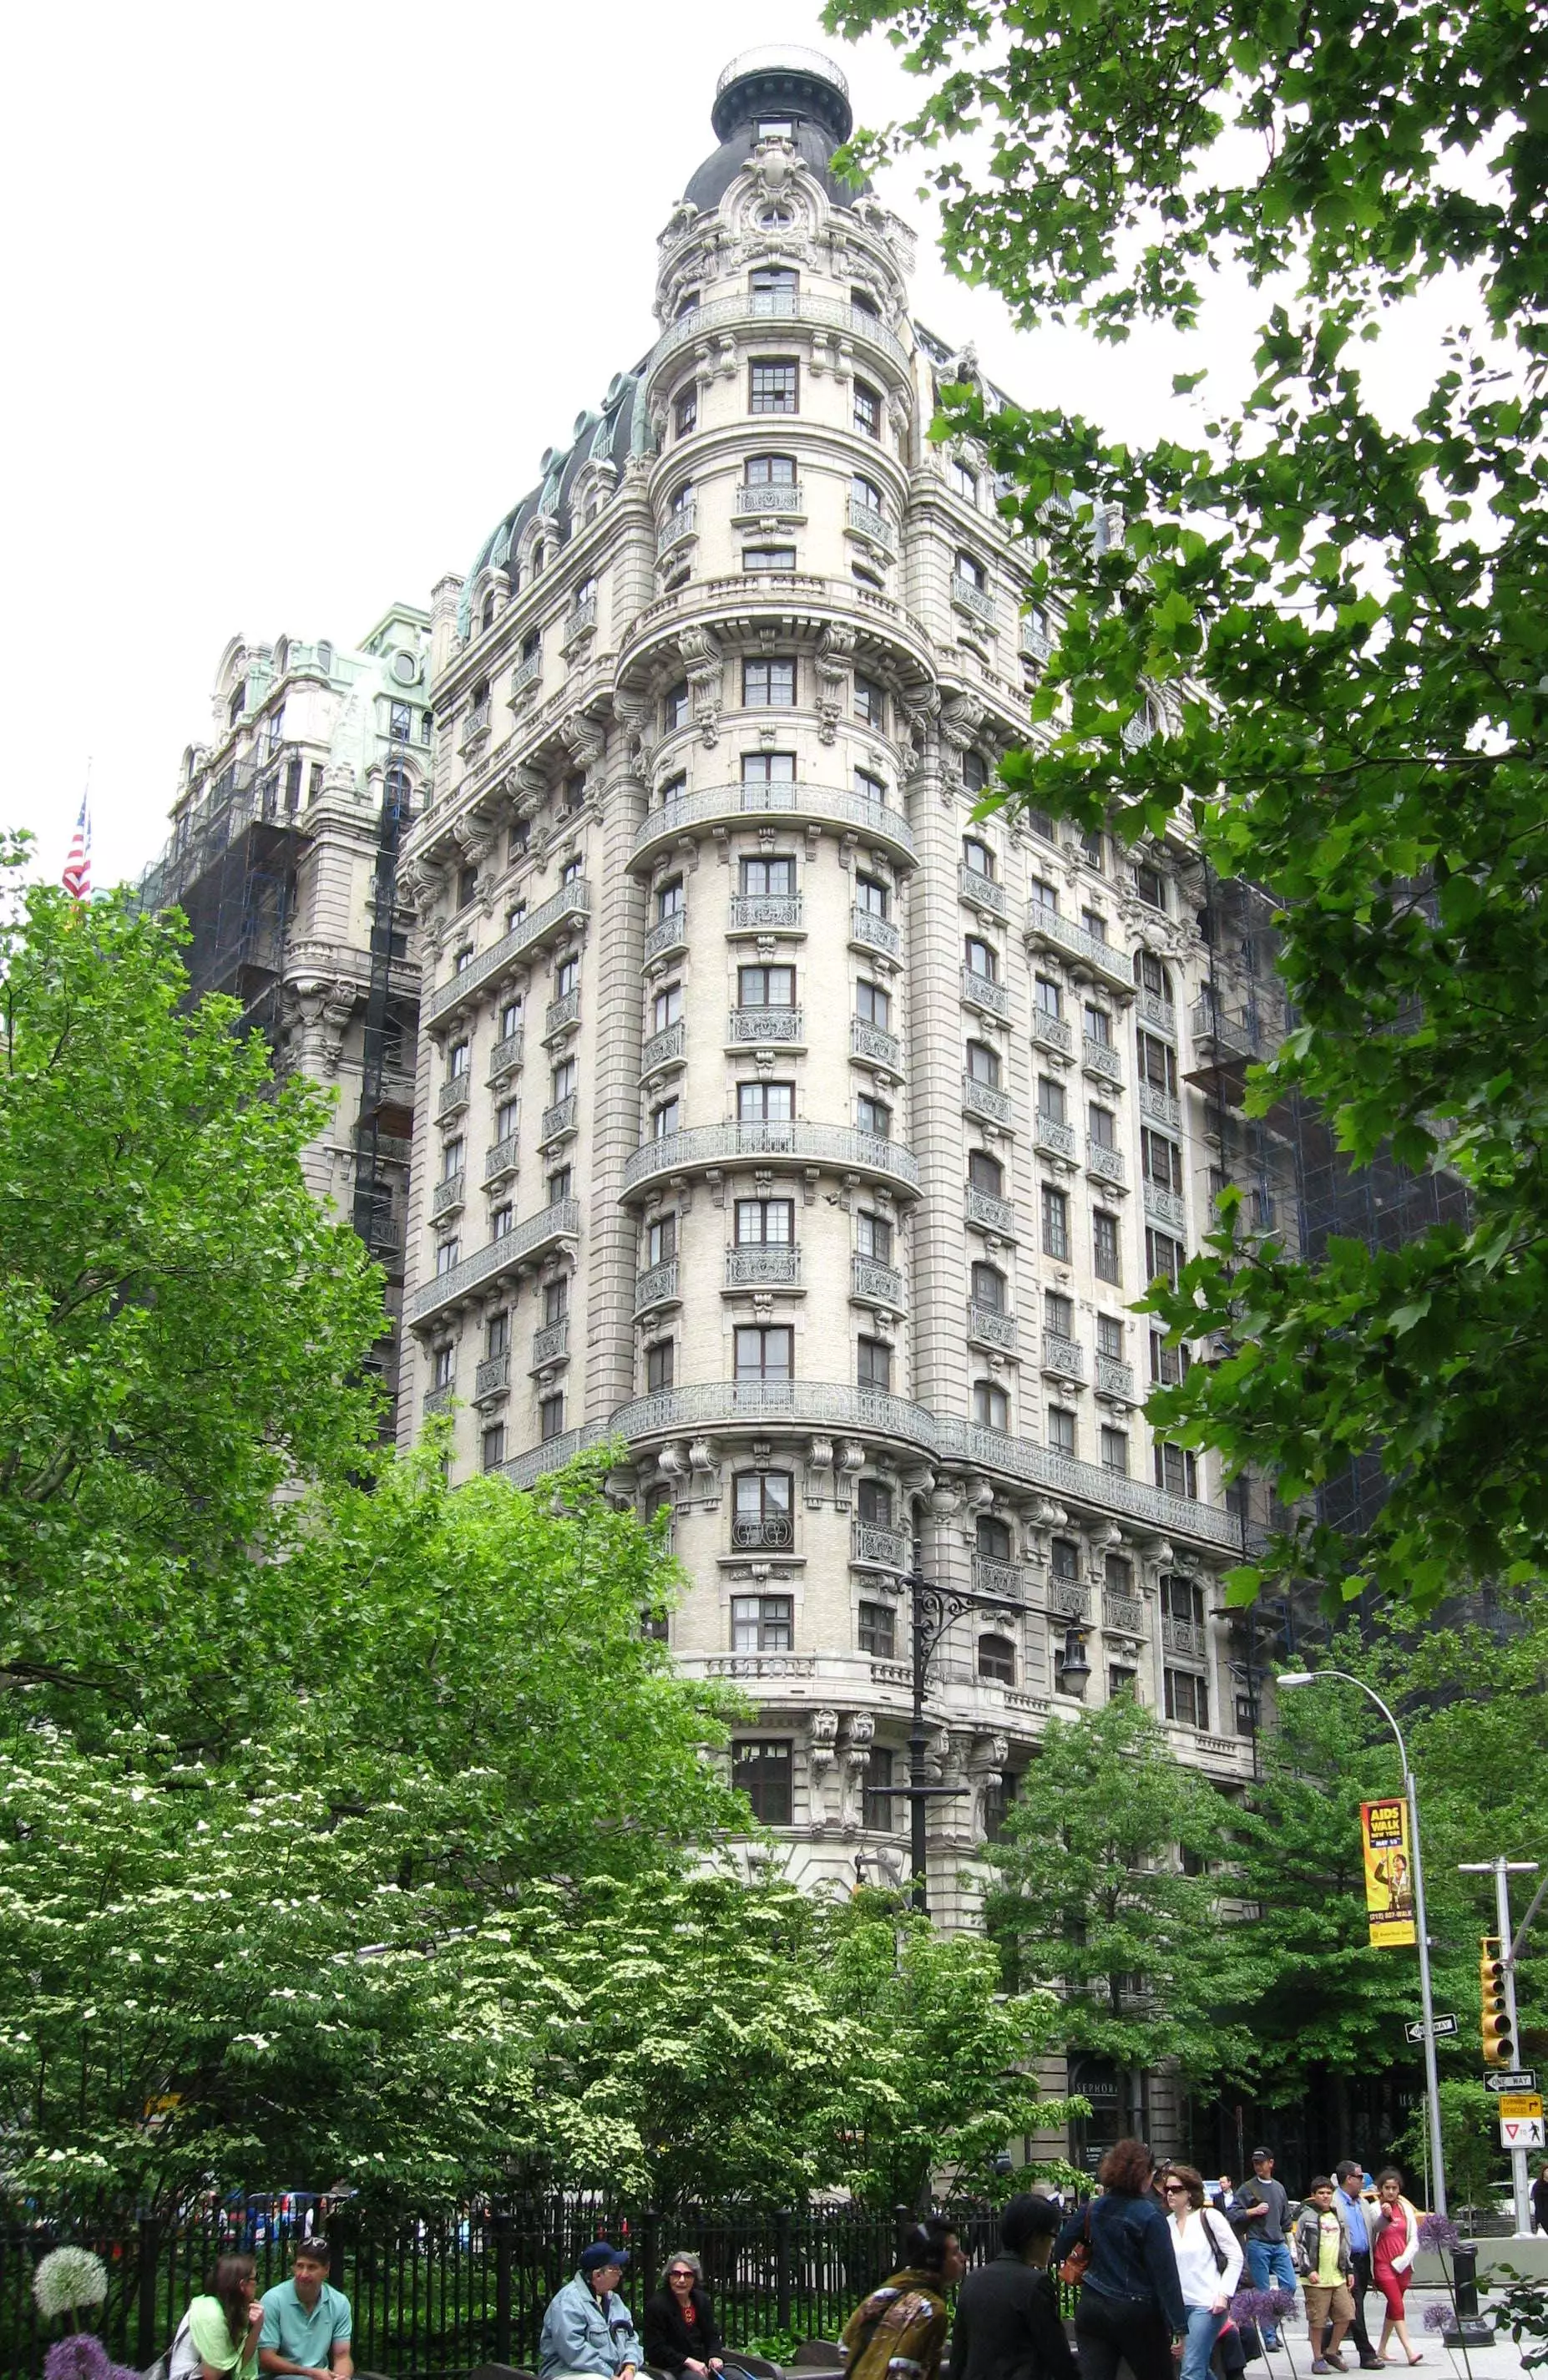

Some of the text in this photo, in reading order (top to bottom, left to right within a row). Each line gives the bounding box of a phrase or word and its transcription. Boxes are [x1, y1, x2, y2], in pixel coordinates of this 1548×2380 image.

[1371, 1807, 1399, 1820] AIDS
[1370, 1820, 1399, 1831] WALK
[1491, 2077, 1528, 2086] ONE WAY
